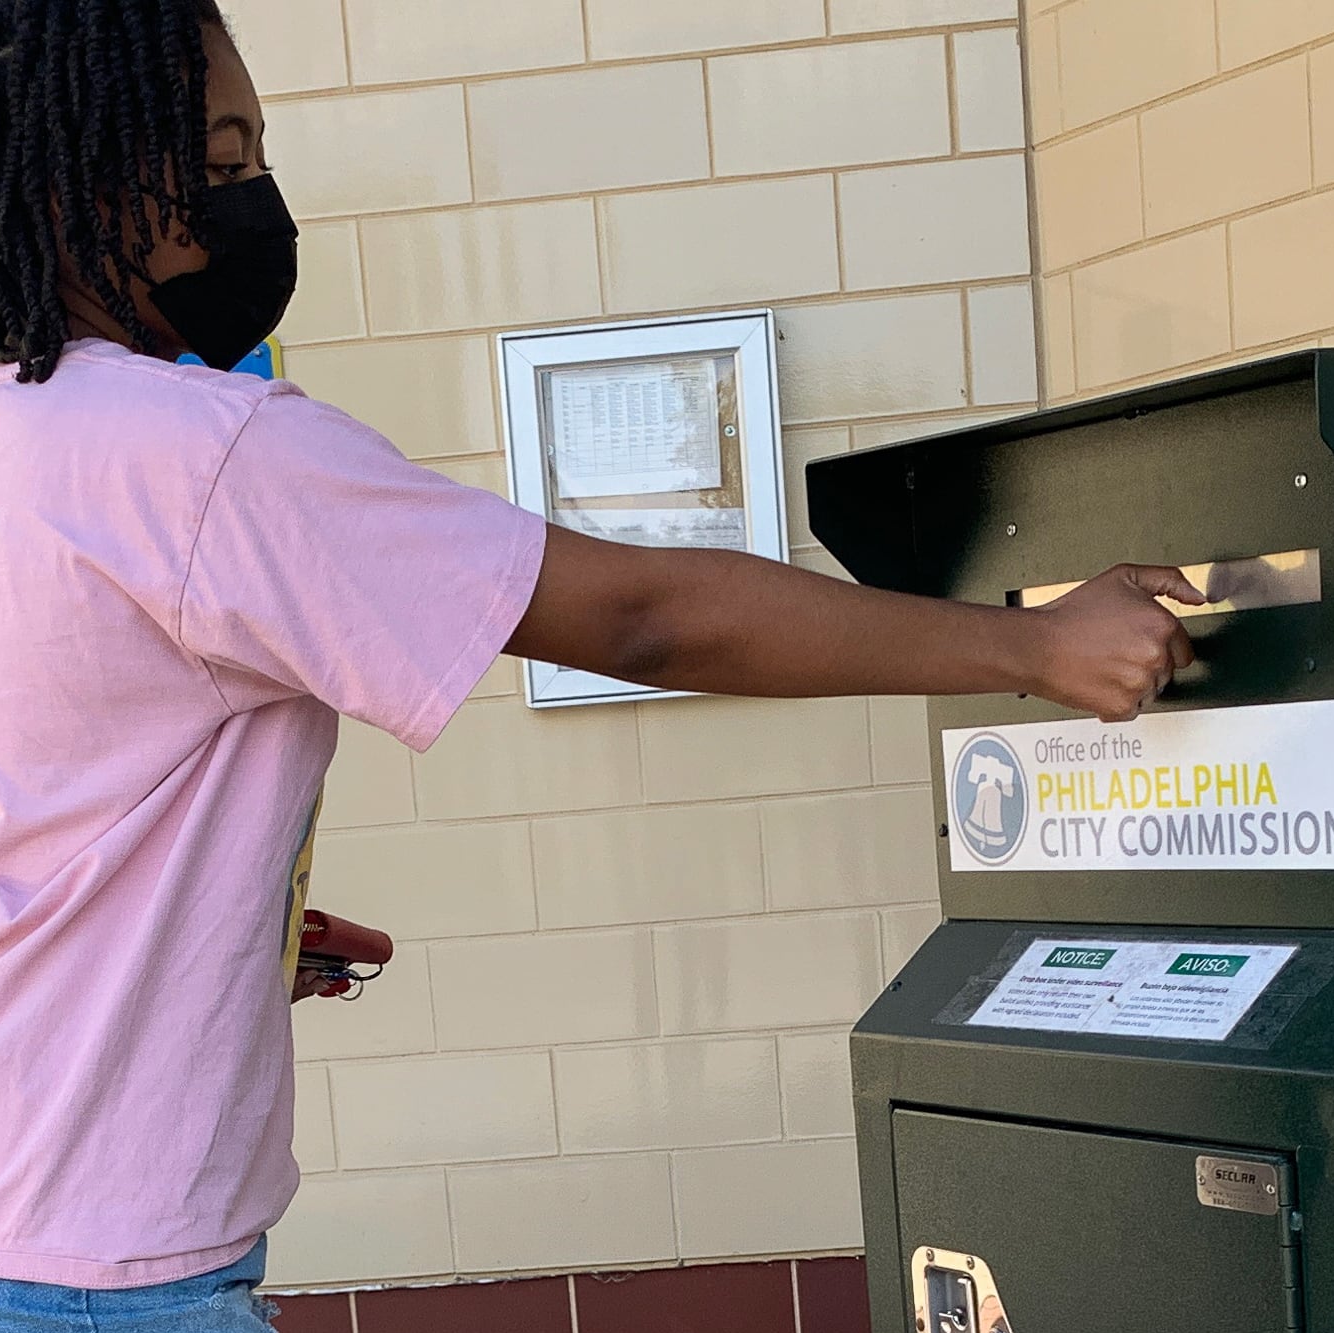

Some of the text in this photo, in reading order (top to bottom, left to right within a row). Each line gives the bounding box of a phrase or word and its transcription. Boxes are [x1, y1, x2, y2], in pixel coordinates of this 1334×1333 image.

[1034, 733, 1142, 764] Office of the
[1037, 762, 1277, 812] PHILADELPHIA
[1039, 817, 1105, 857] CITY
[1049, 949, 1105, 966] NOTICE:
[1178, 957, 1231, 974] AVISO:
